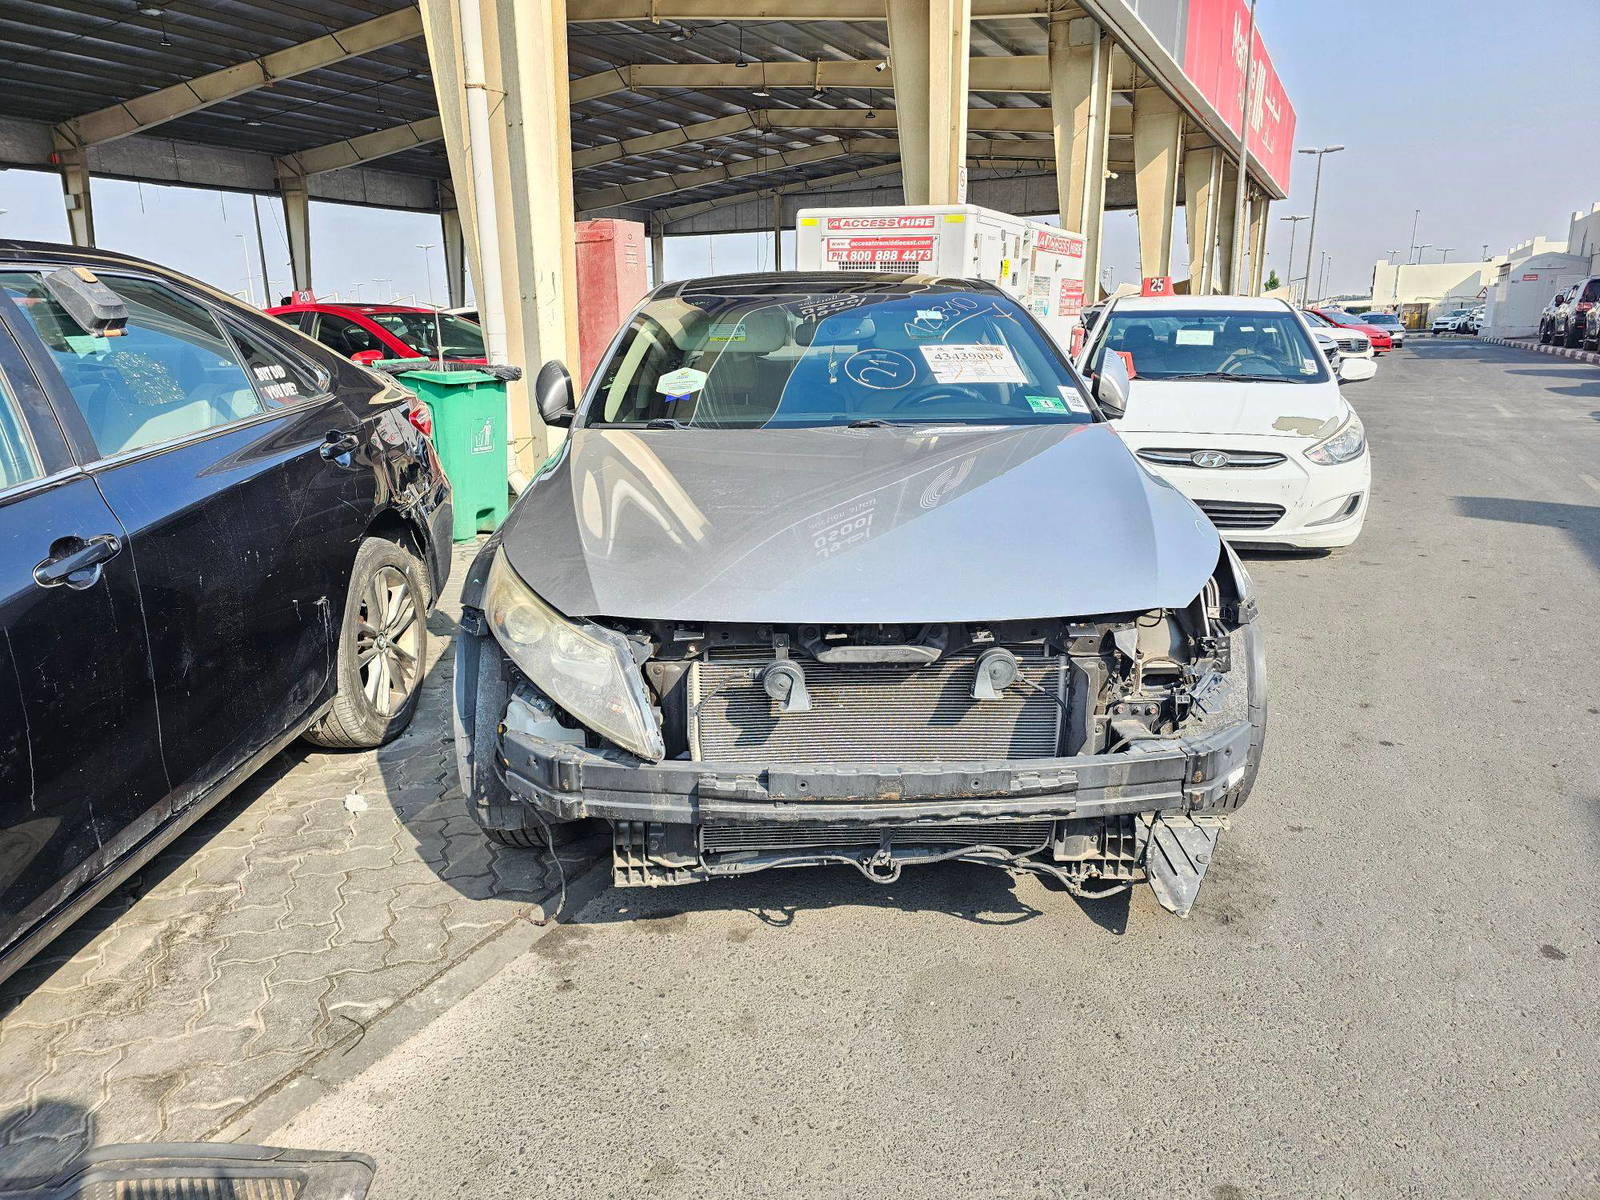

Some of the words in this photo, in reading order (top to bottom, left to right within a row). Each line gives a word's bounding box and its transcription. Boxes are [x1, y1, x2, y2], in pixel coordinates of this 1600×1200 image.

[843, 219, 896, 228] ACCESS
[900, 218, 934, 227] HIRE
[850, 250, 872, 261] 800
[875, 250, 898, 261] 888
[902, 249, 931, 261] 4473
[1151, 278, 1164, 292] 25
[299, 291, 311, 303] 20
[253, 366, 273, 381] BUT
[269, 365, 286, 379] DID
[264, 384, 285, 399] YOU
[280, 382, 299, 397] DIE?
